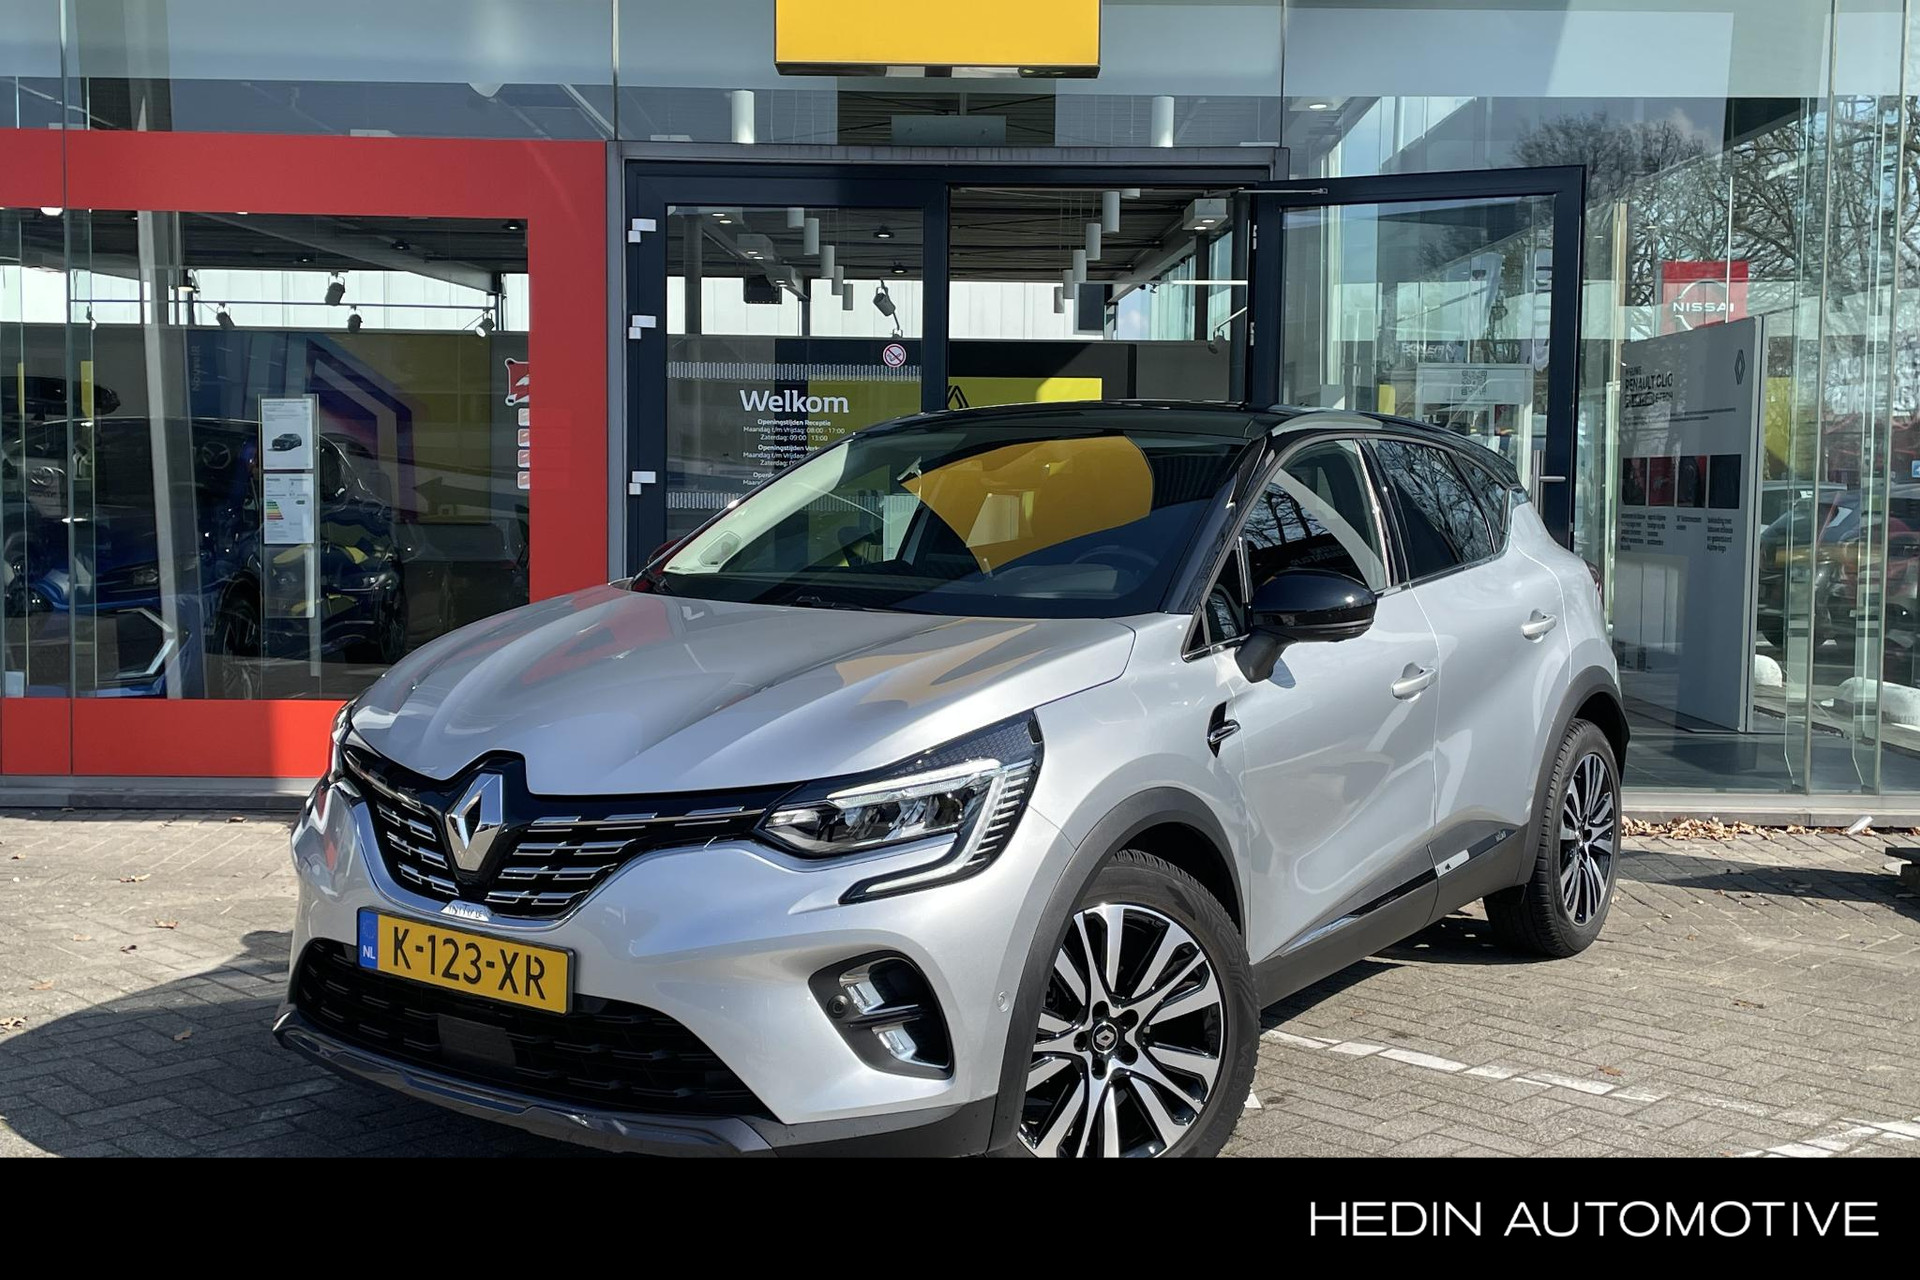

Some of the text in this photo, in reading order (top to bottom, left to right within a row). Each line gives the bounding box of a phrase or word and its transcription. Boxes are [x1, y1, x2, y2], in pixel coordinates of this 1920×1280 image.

[739, 389, 849, 413] Welkom
[757, 419, 803, 427] Openingstijden
[743, 426, 770, 434] Maandag
[757, 444, 804, 452] Openingstijden
[743, 452, 770, 460] Maandag
[362, 945, 376, 960] NL
[393, 926, 546, 1000] K-123-XR
